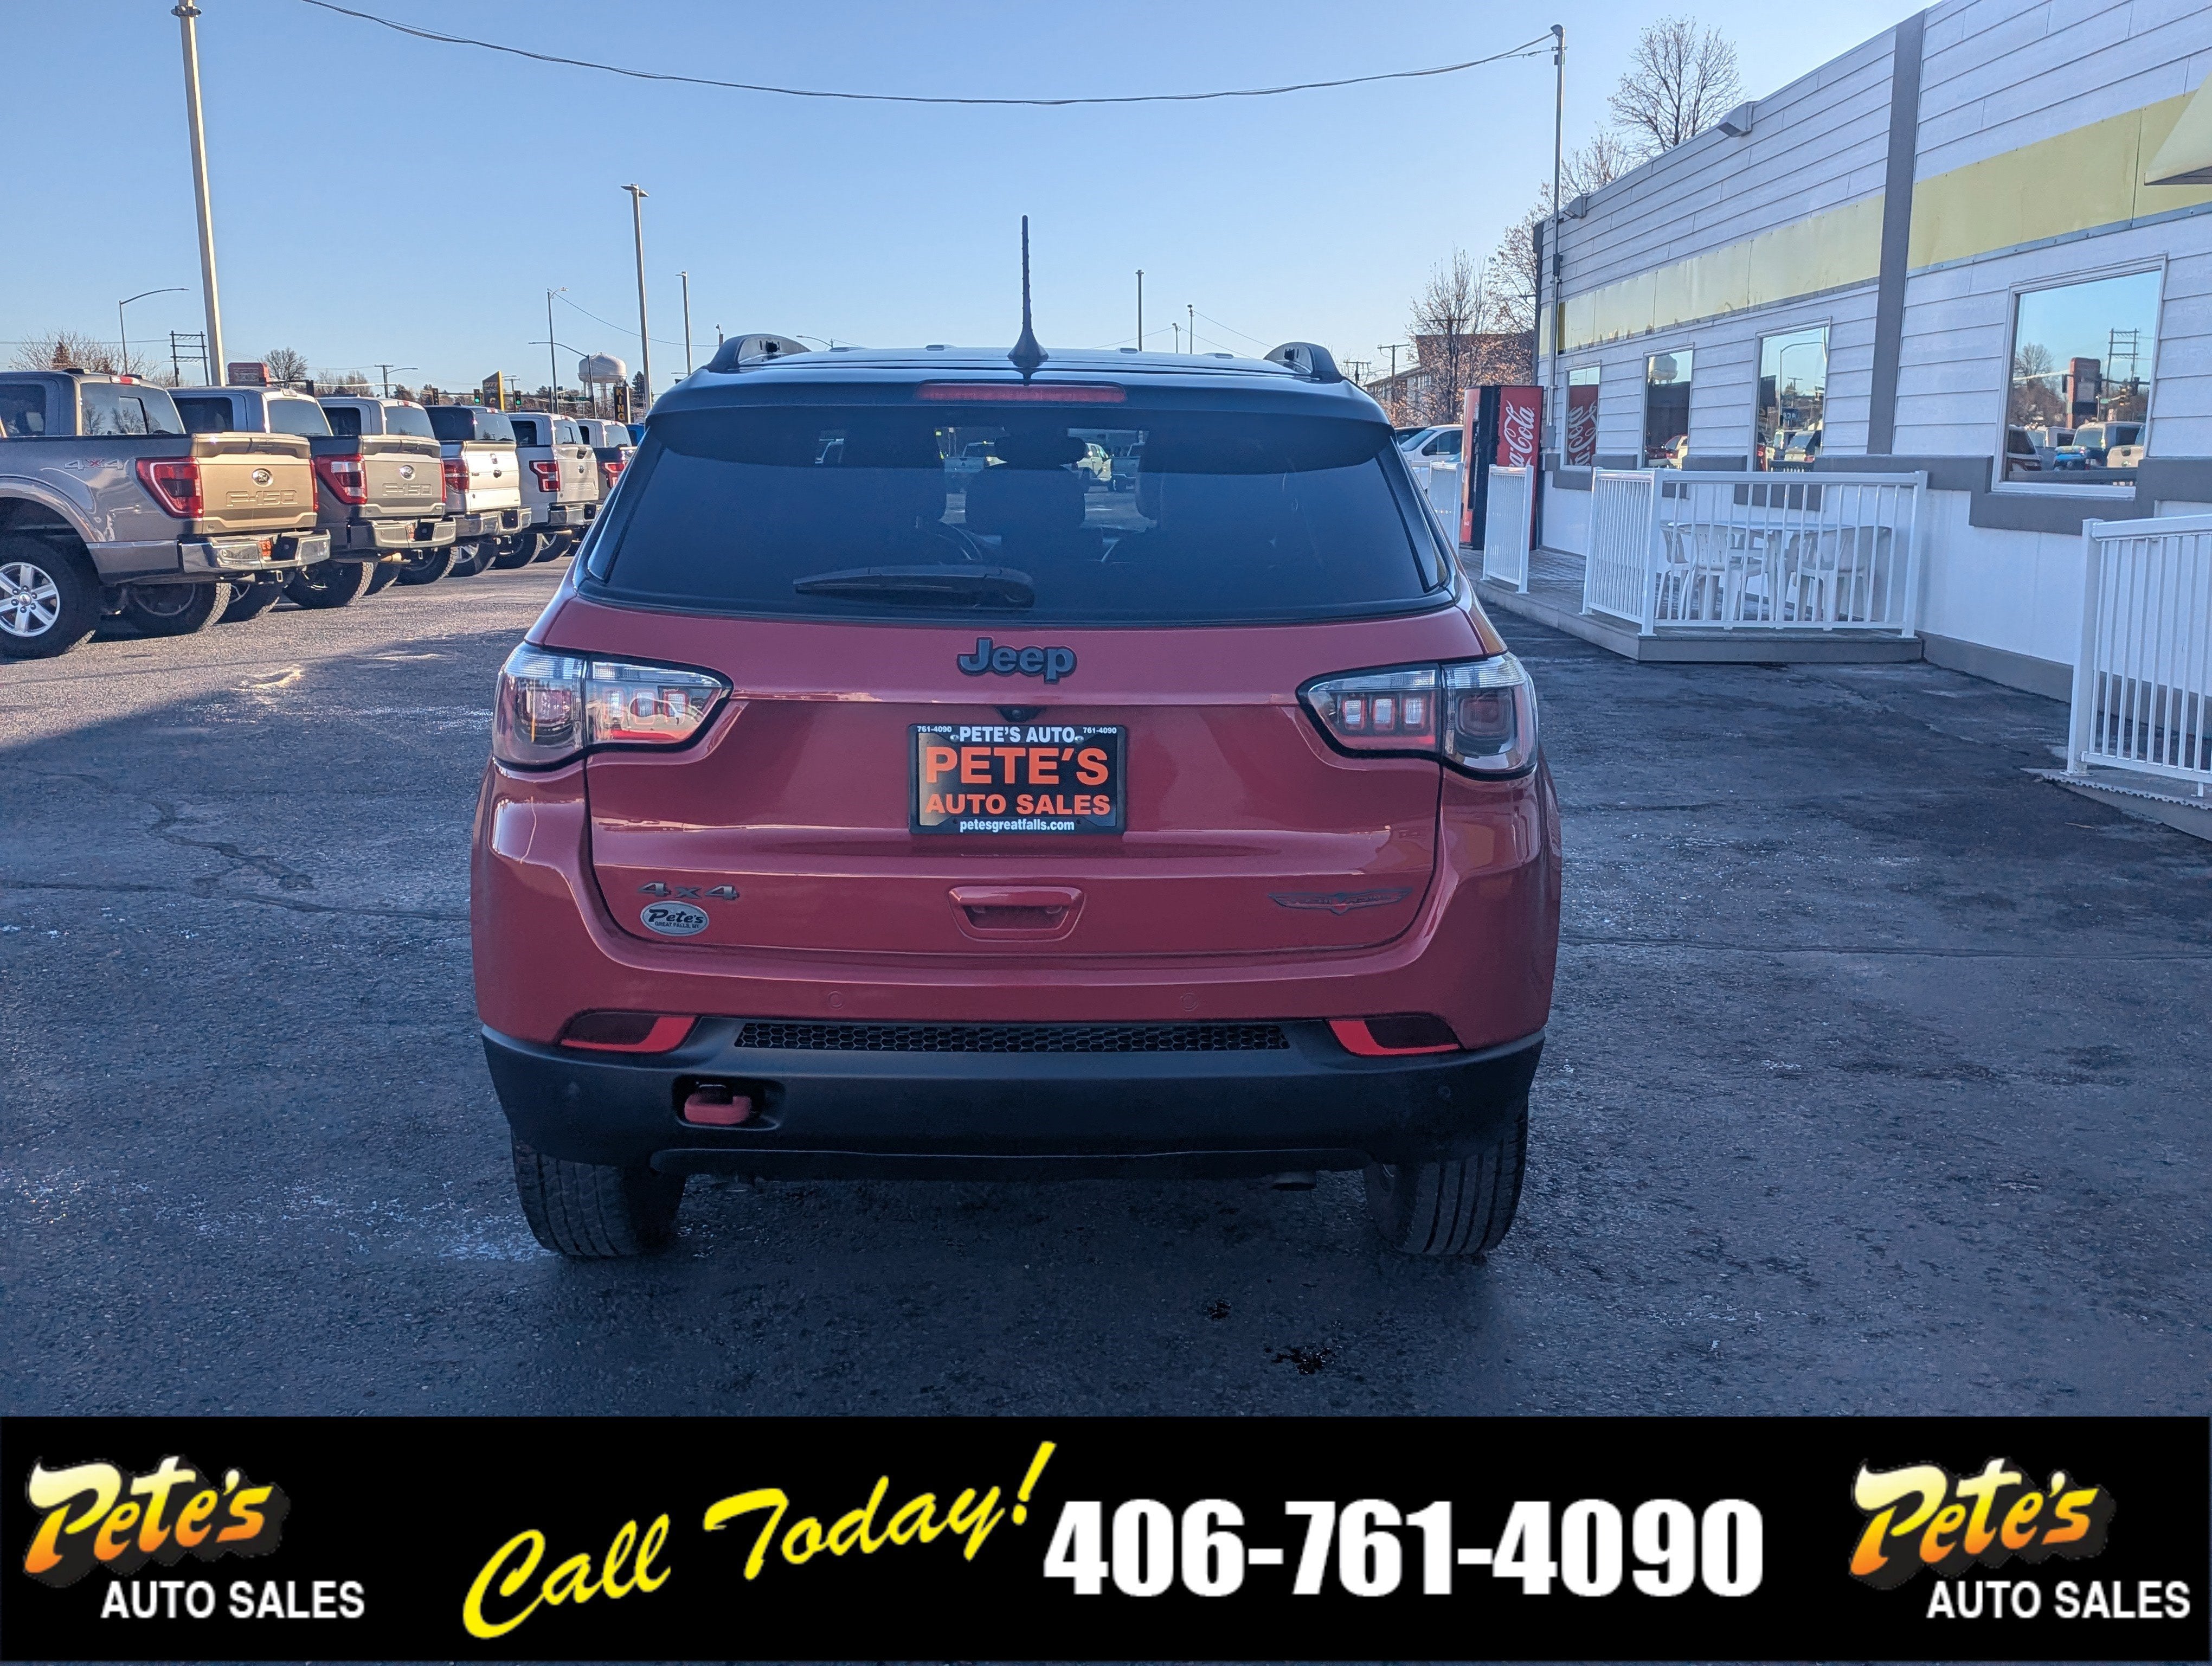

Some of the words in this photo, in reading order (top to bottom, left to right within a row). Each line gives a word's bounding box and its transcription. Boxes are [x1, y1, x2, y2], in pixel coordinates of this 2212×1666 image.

[616, 388, 625, 421] KING
[226, 489, 298, 507] F-150
[382, 483, 432, 496] F-150
[959, 638, 1076, 683] Jeep
[959, 726, 1021, 742] PETE'S
[1026, 727, 1076, 743] AUTO
[925, 746, 1109, 785] PETE'S
[924, 793, 1007, 814] AUTO
[1016, 794, 1111, 815] SALES
[959, 818, 1075, 833] petesgreatfalls.com
[638, 882, 740, 901] 4x4
[648, 908, 704, 924] Pete's
